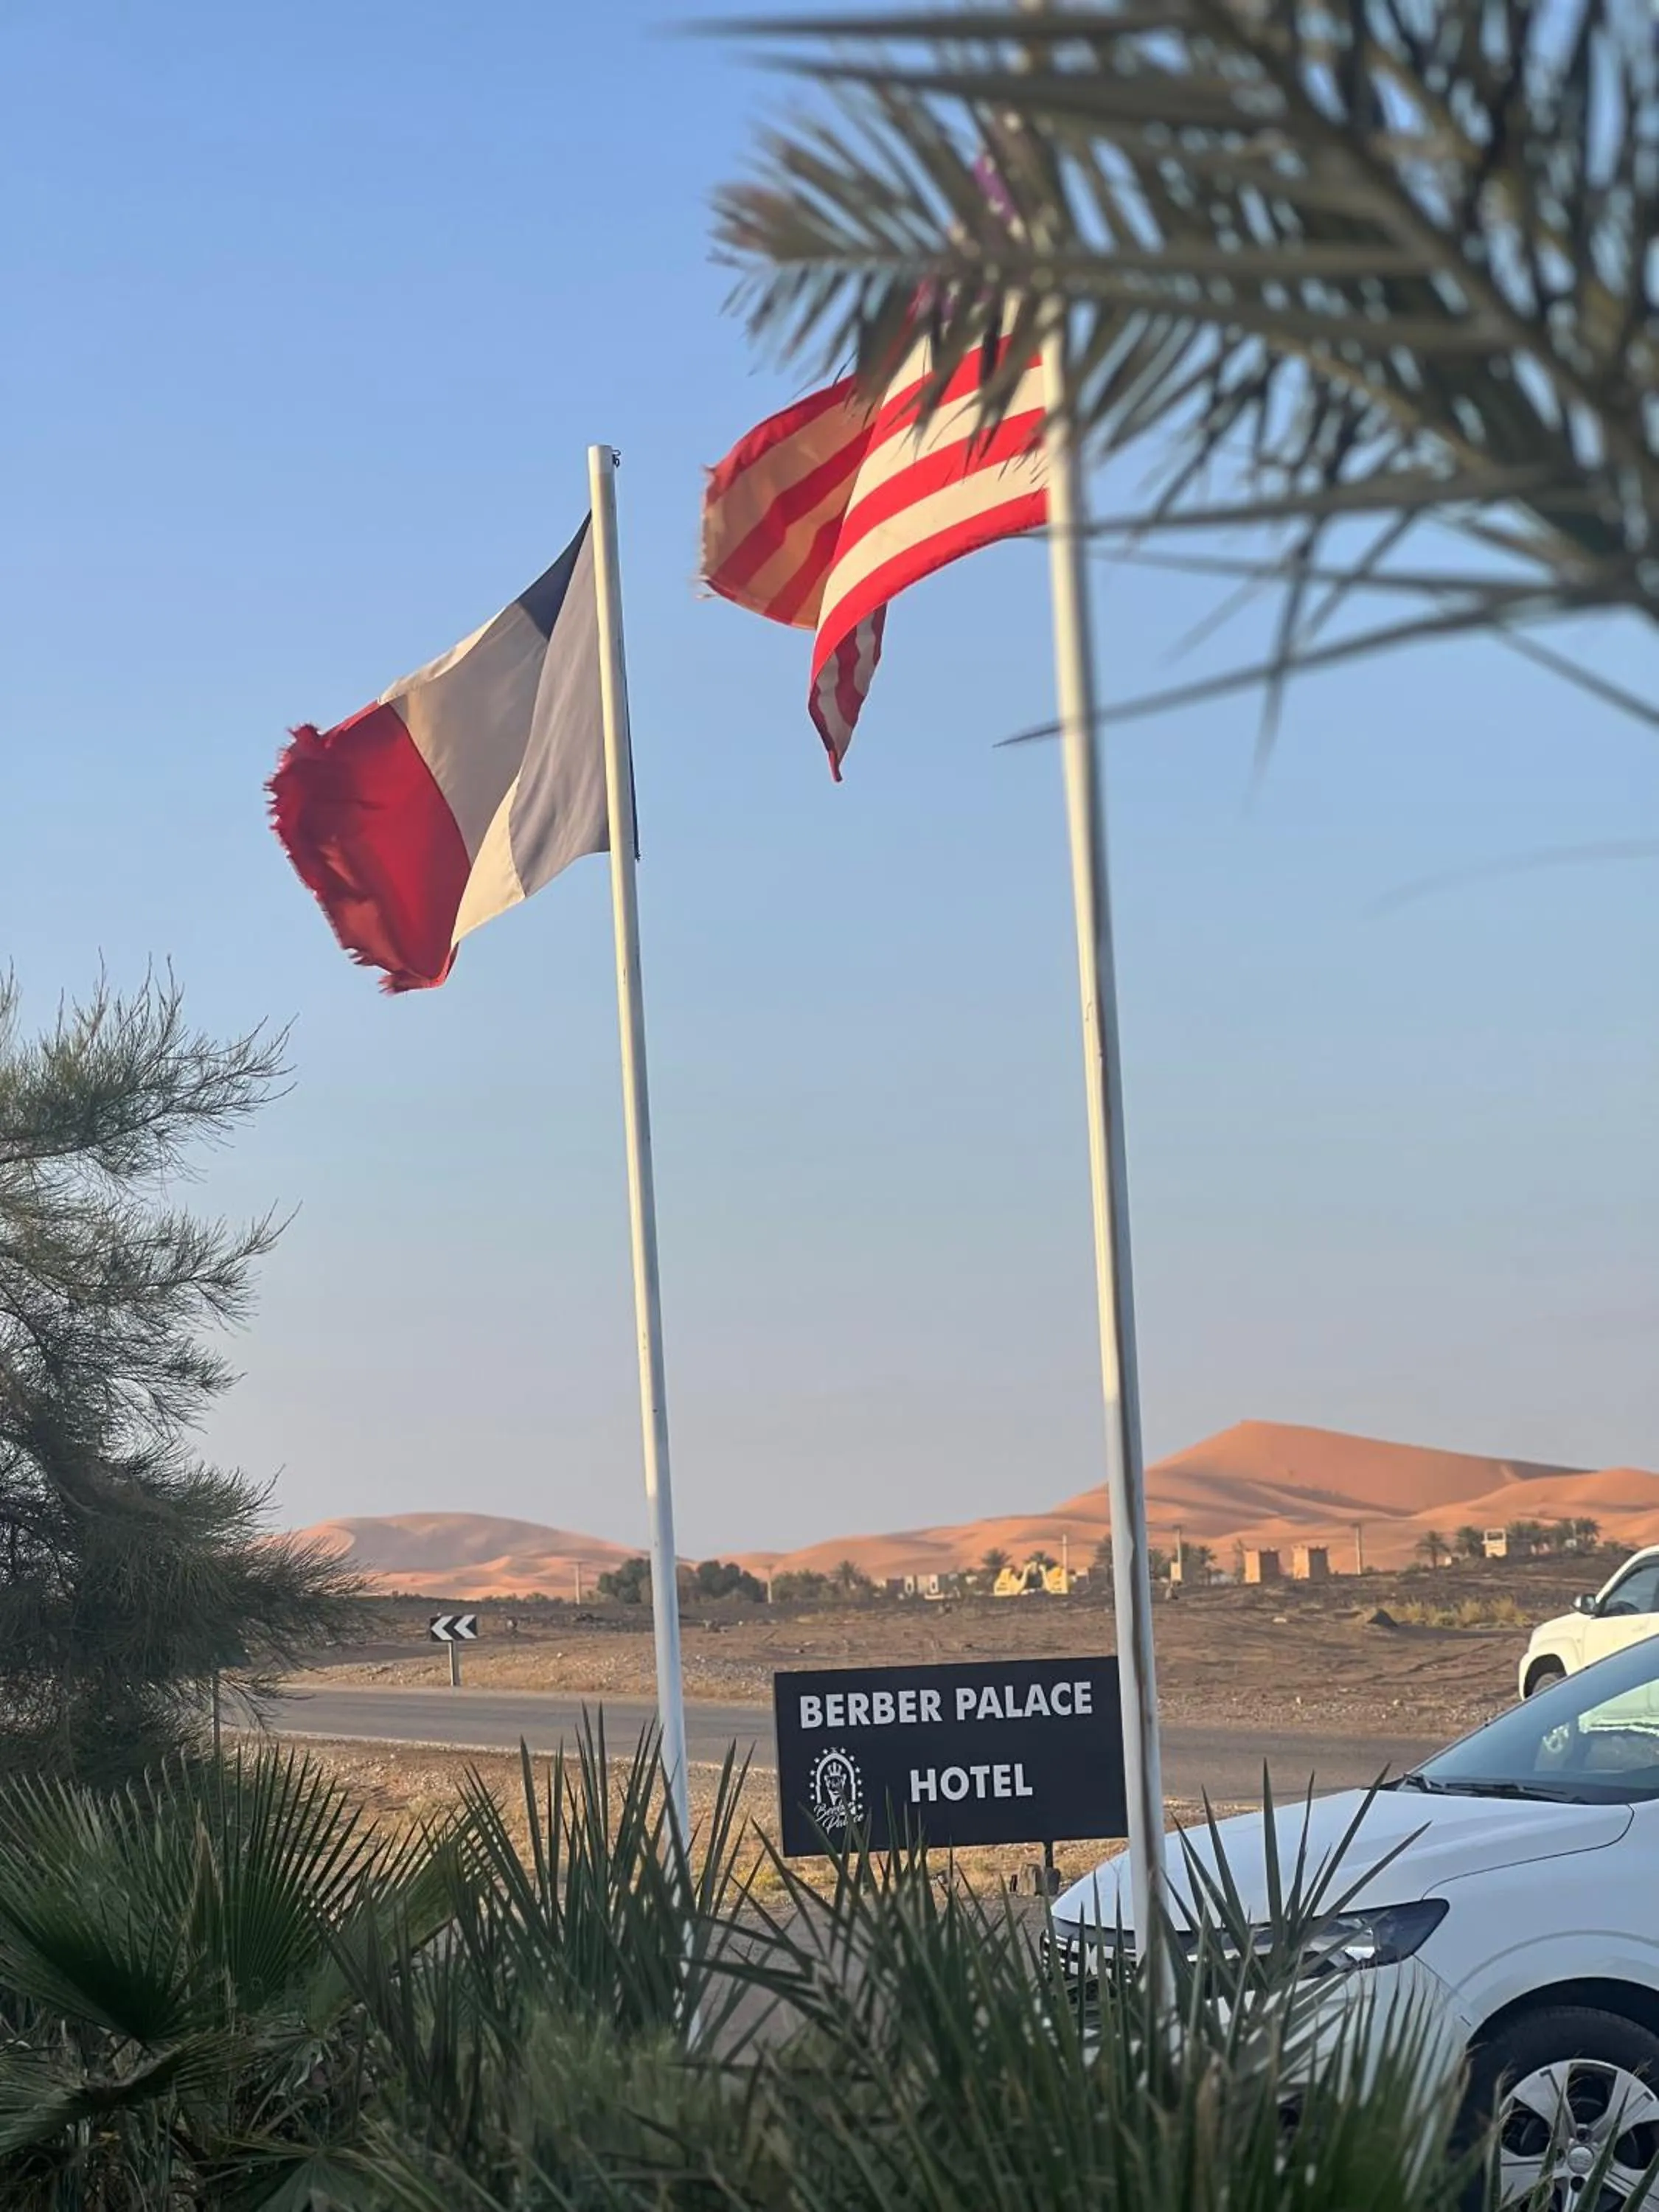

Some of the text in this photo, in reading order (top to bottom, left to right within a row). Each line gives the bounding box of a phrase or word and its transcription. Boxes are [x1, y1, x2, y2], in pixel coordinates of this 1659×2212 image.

[800, 1681, 1093, 1729] BERBER PALACE
[910, 1763, 1033, 1803] HOTEL
[822, 1813, 864, 1835] Palce
